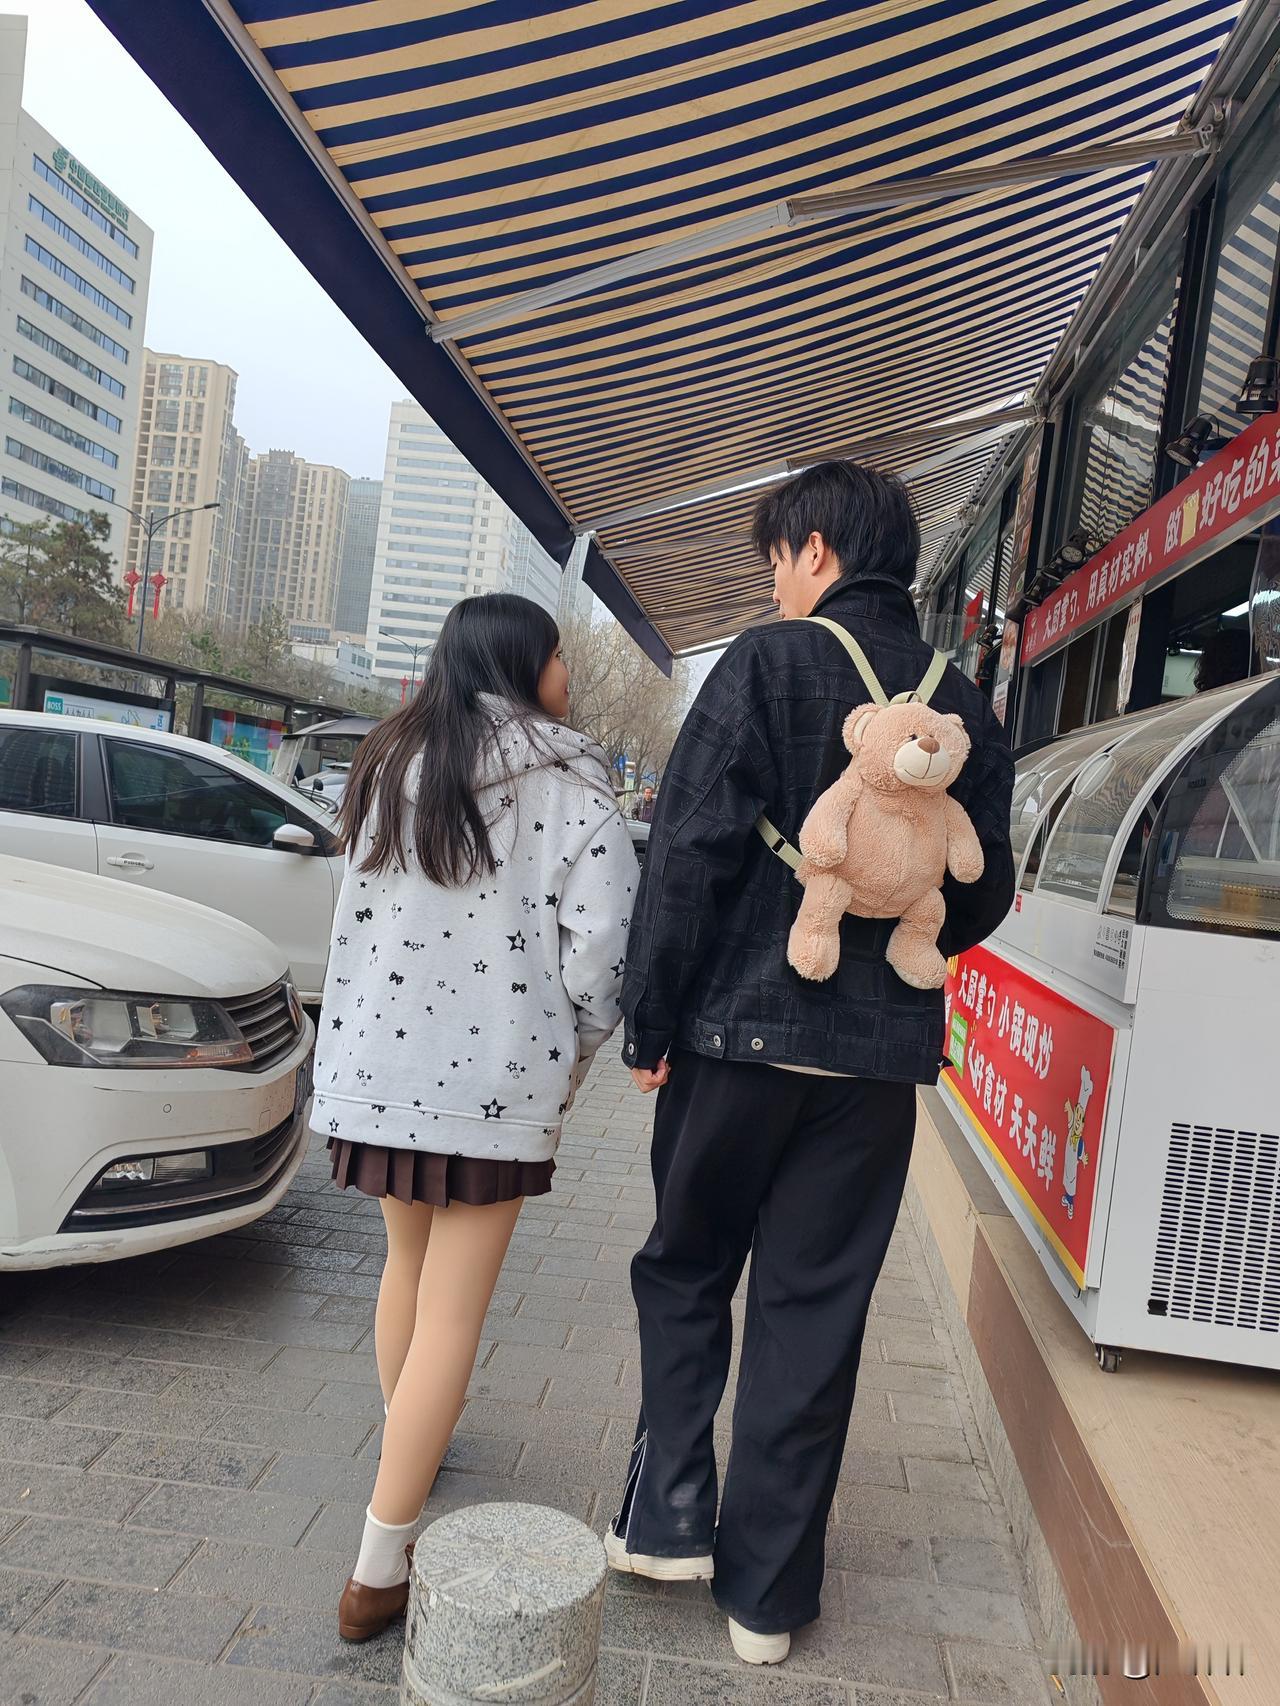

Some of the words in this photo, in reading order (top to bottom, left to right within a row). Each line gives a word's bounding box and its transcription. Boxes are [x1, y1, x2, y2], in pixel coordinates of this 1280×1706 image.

[1164, 428, 1280, 556] 做好吃的
[958, 963, 997, 1029] 大厨掌勺
[997, 995, 1053, 1080] 小锅现炒
[1008, 1093, 1057, 1192] 天天鲜
